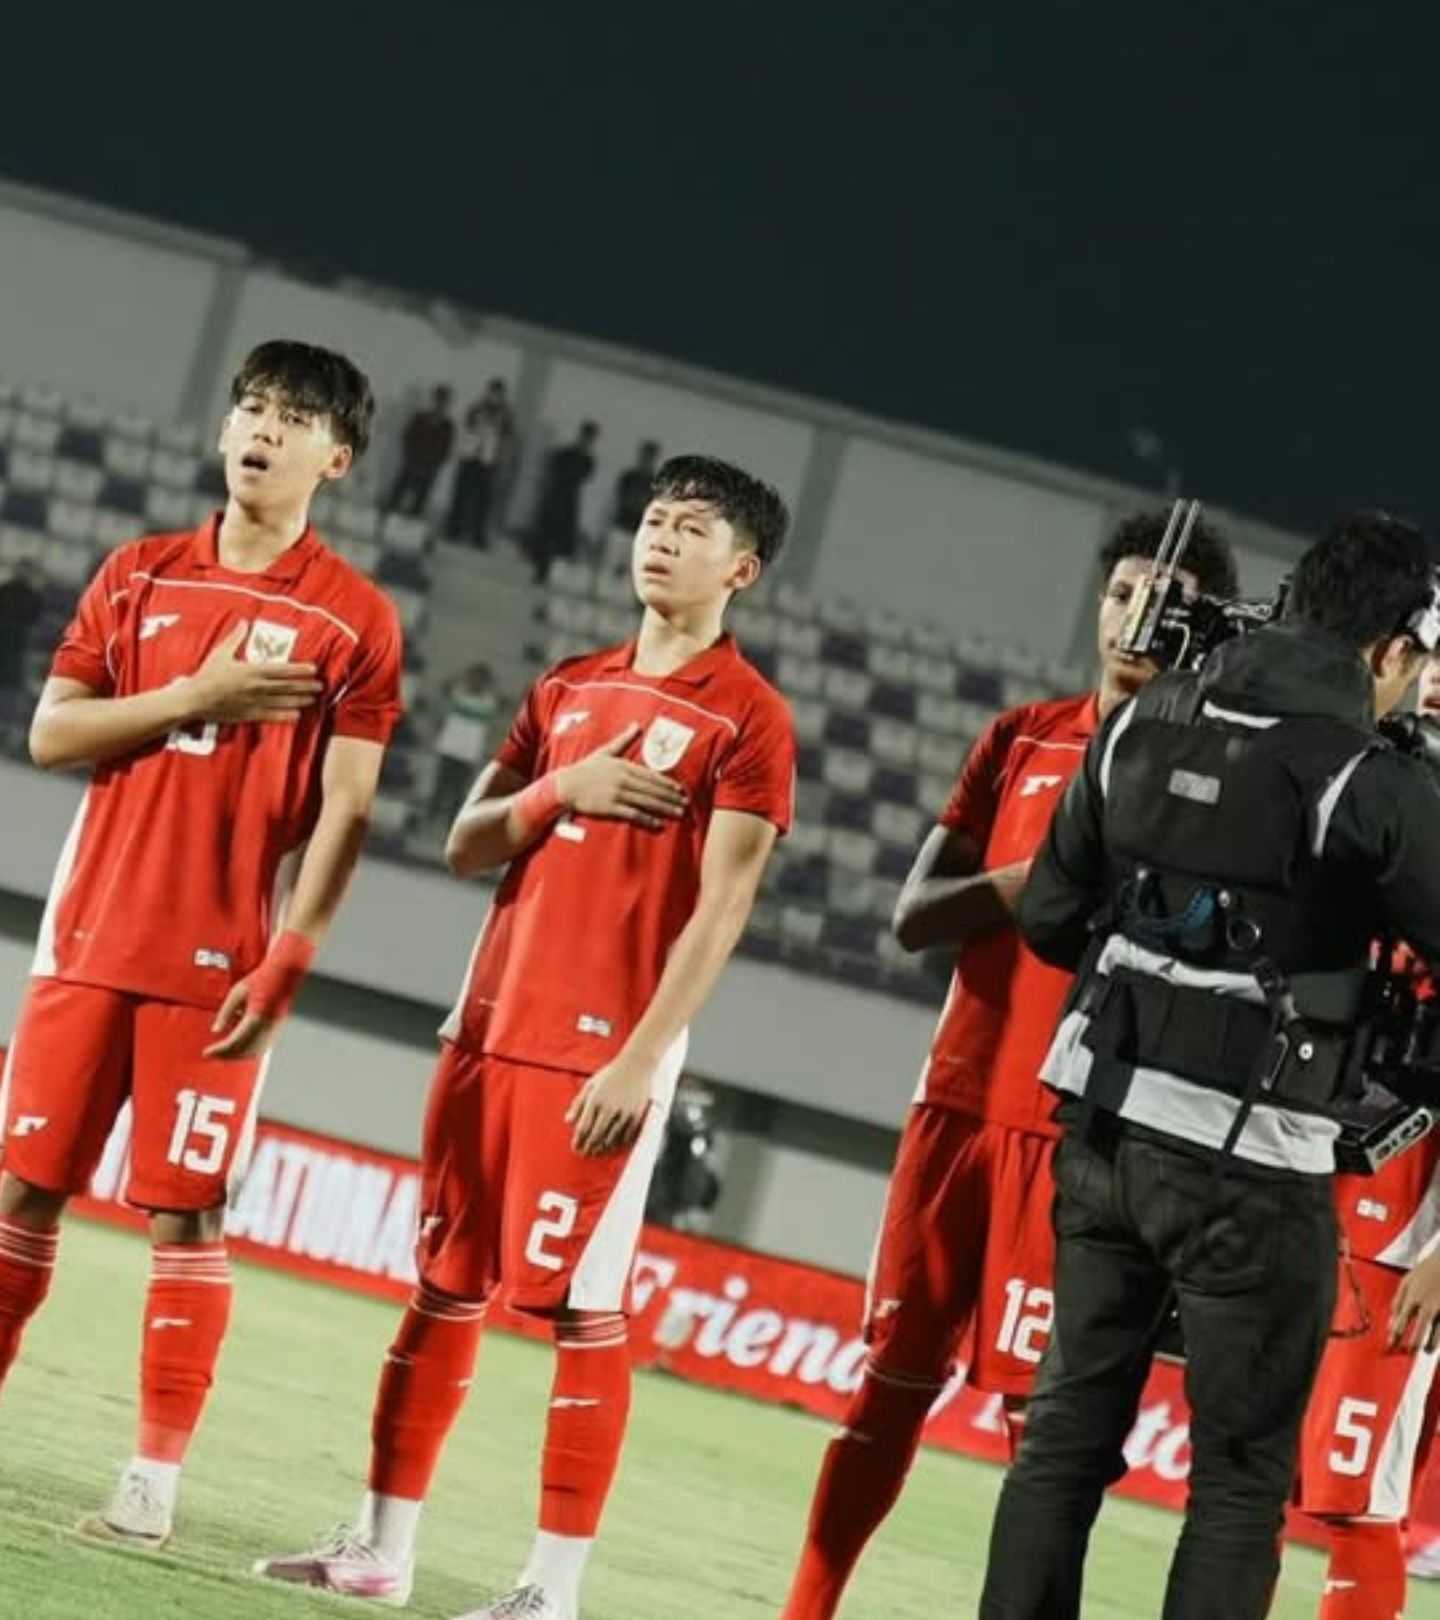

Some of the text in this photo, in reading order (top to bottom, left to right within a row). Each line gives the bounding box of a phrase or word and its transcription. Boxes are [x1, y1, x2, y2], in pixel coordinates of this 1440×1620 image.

[167, 1088, 236, 1176] 15
[525, 1189, 579, 1271] 2
[996, 1278, 1055, 1364] 12
[1329, 1395, 1378, 1477] 5
